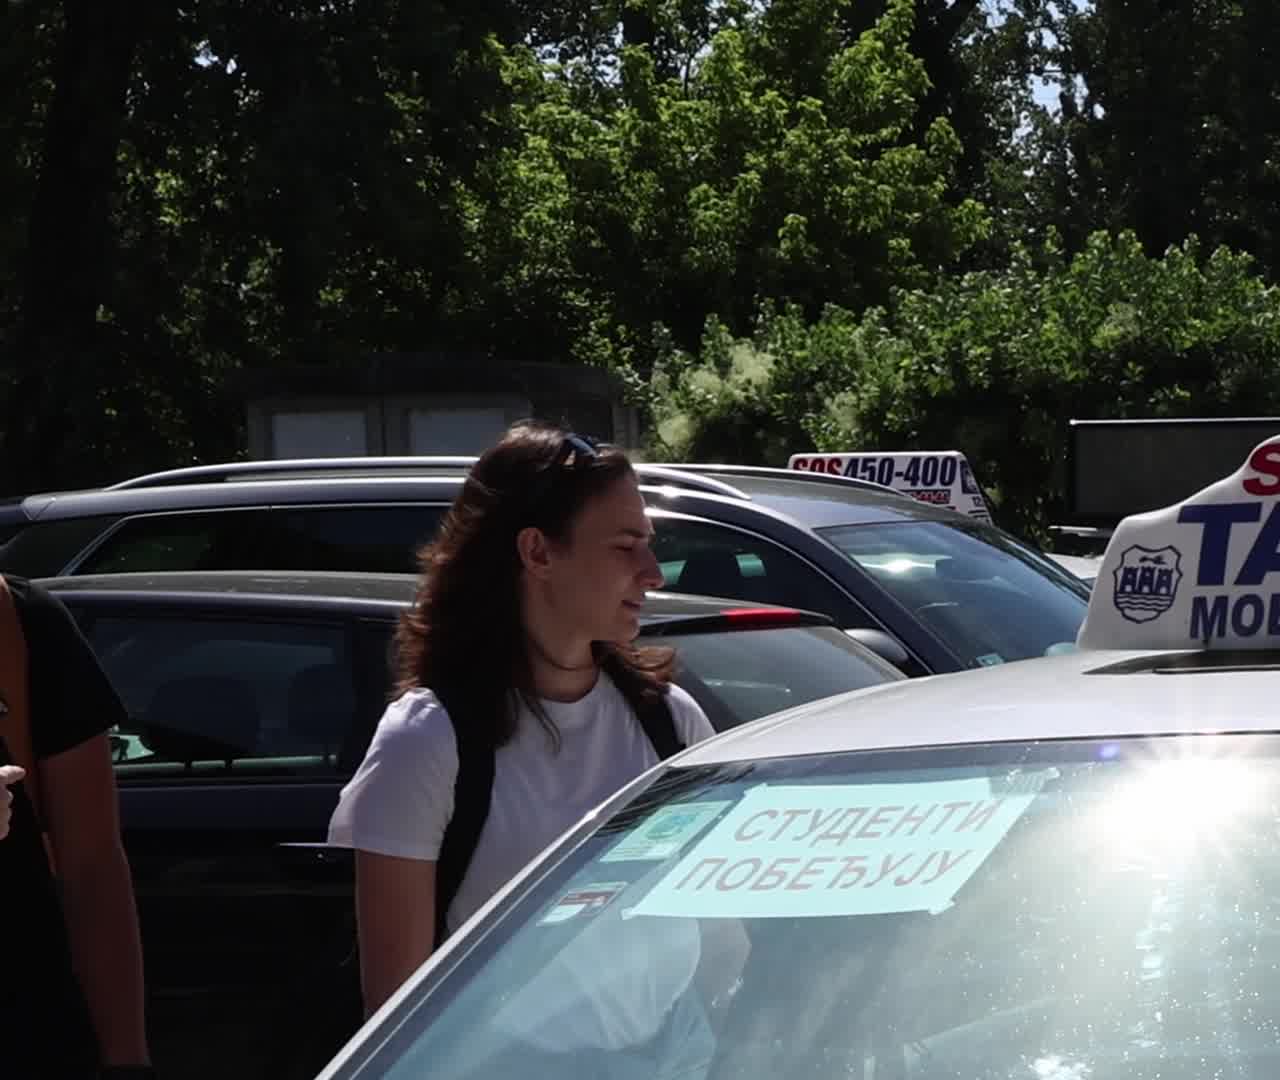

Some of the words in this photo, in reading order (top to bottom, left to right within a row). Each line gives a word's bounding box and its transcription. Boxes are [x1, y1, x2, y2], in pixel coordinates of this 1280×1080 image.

[844, 456, 958, 487] 450-400
[734, 800, 998, 848] СТУДЕНТИ
[674, 850, 978, 893] ПОБЕЂУЈУ
